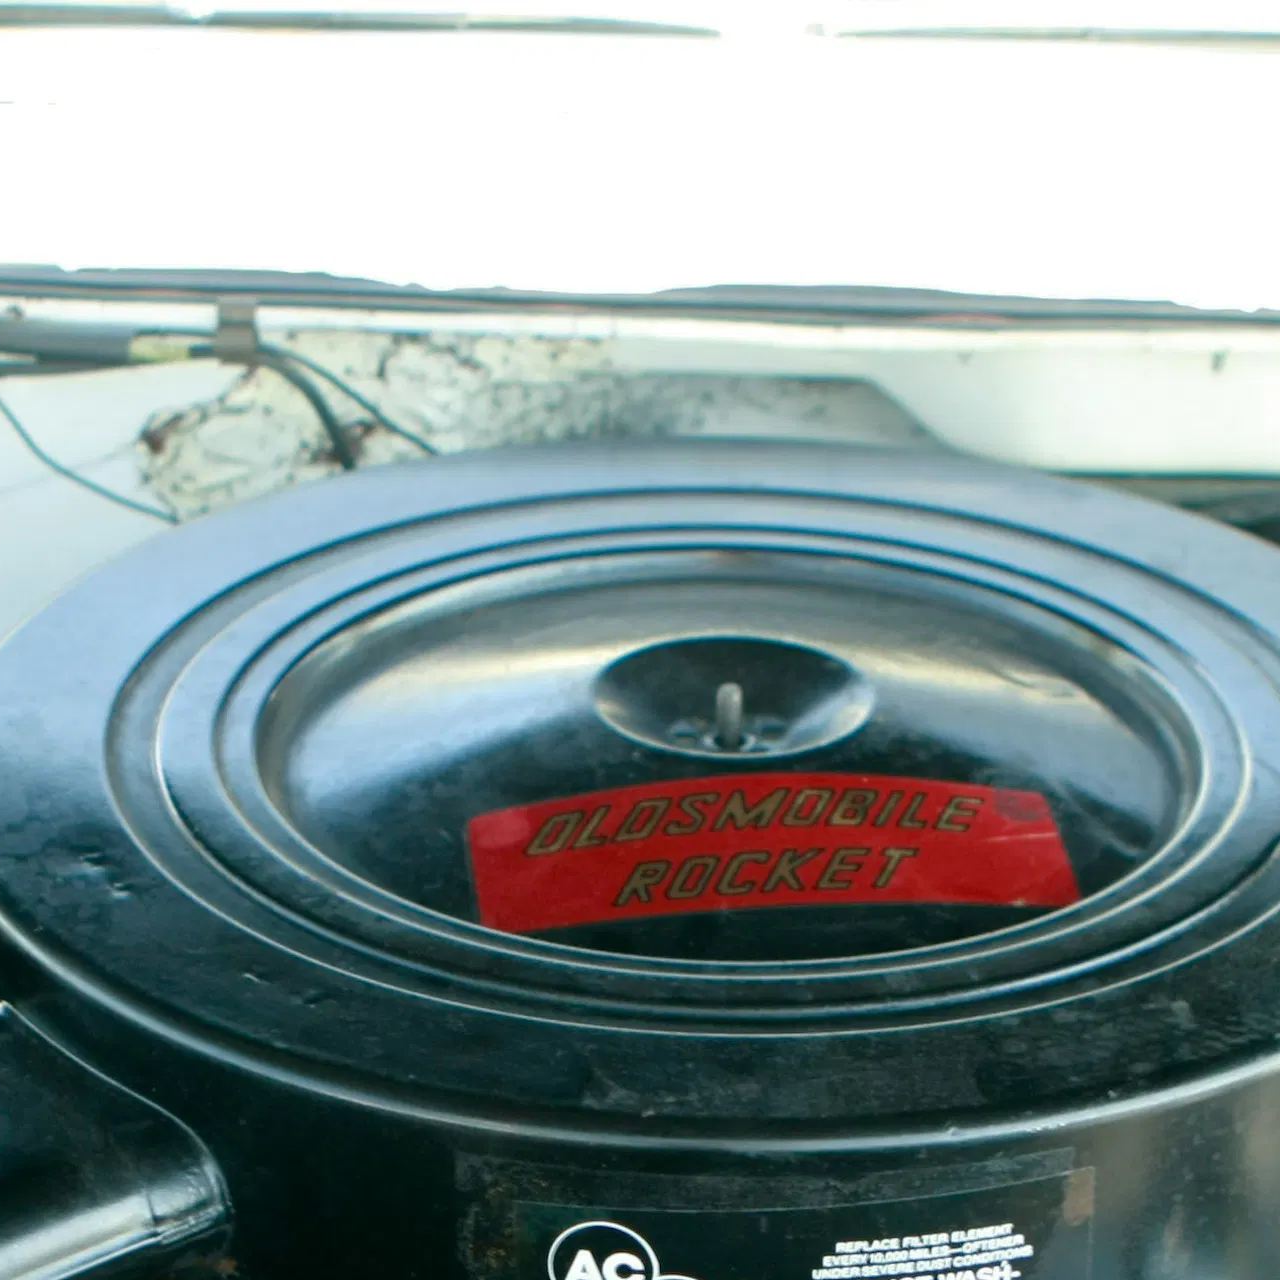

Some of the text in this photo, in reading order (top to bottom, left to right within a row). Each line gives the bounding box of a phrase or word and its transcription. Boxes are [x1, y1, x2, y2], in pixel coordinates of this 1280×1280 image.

[525, 787, 984, 857] OLDSMOBILE
[613, 846, 923, 908] ROCKET
[835, 1223, 1014, 1254] REPLACE FILTER ELEMENT
[812, 1245, 1034, 1280] UNDER SEVERE DUST CONDITIONS
[822, 1254, 868, 1268] EVERY
